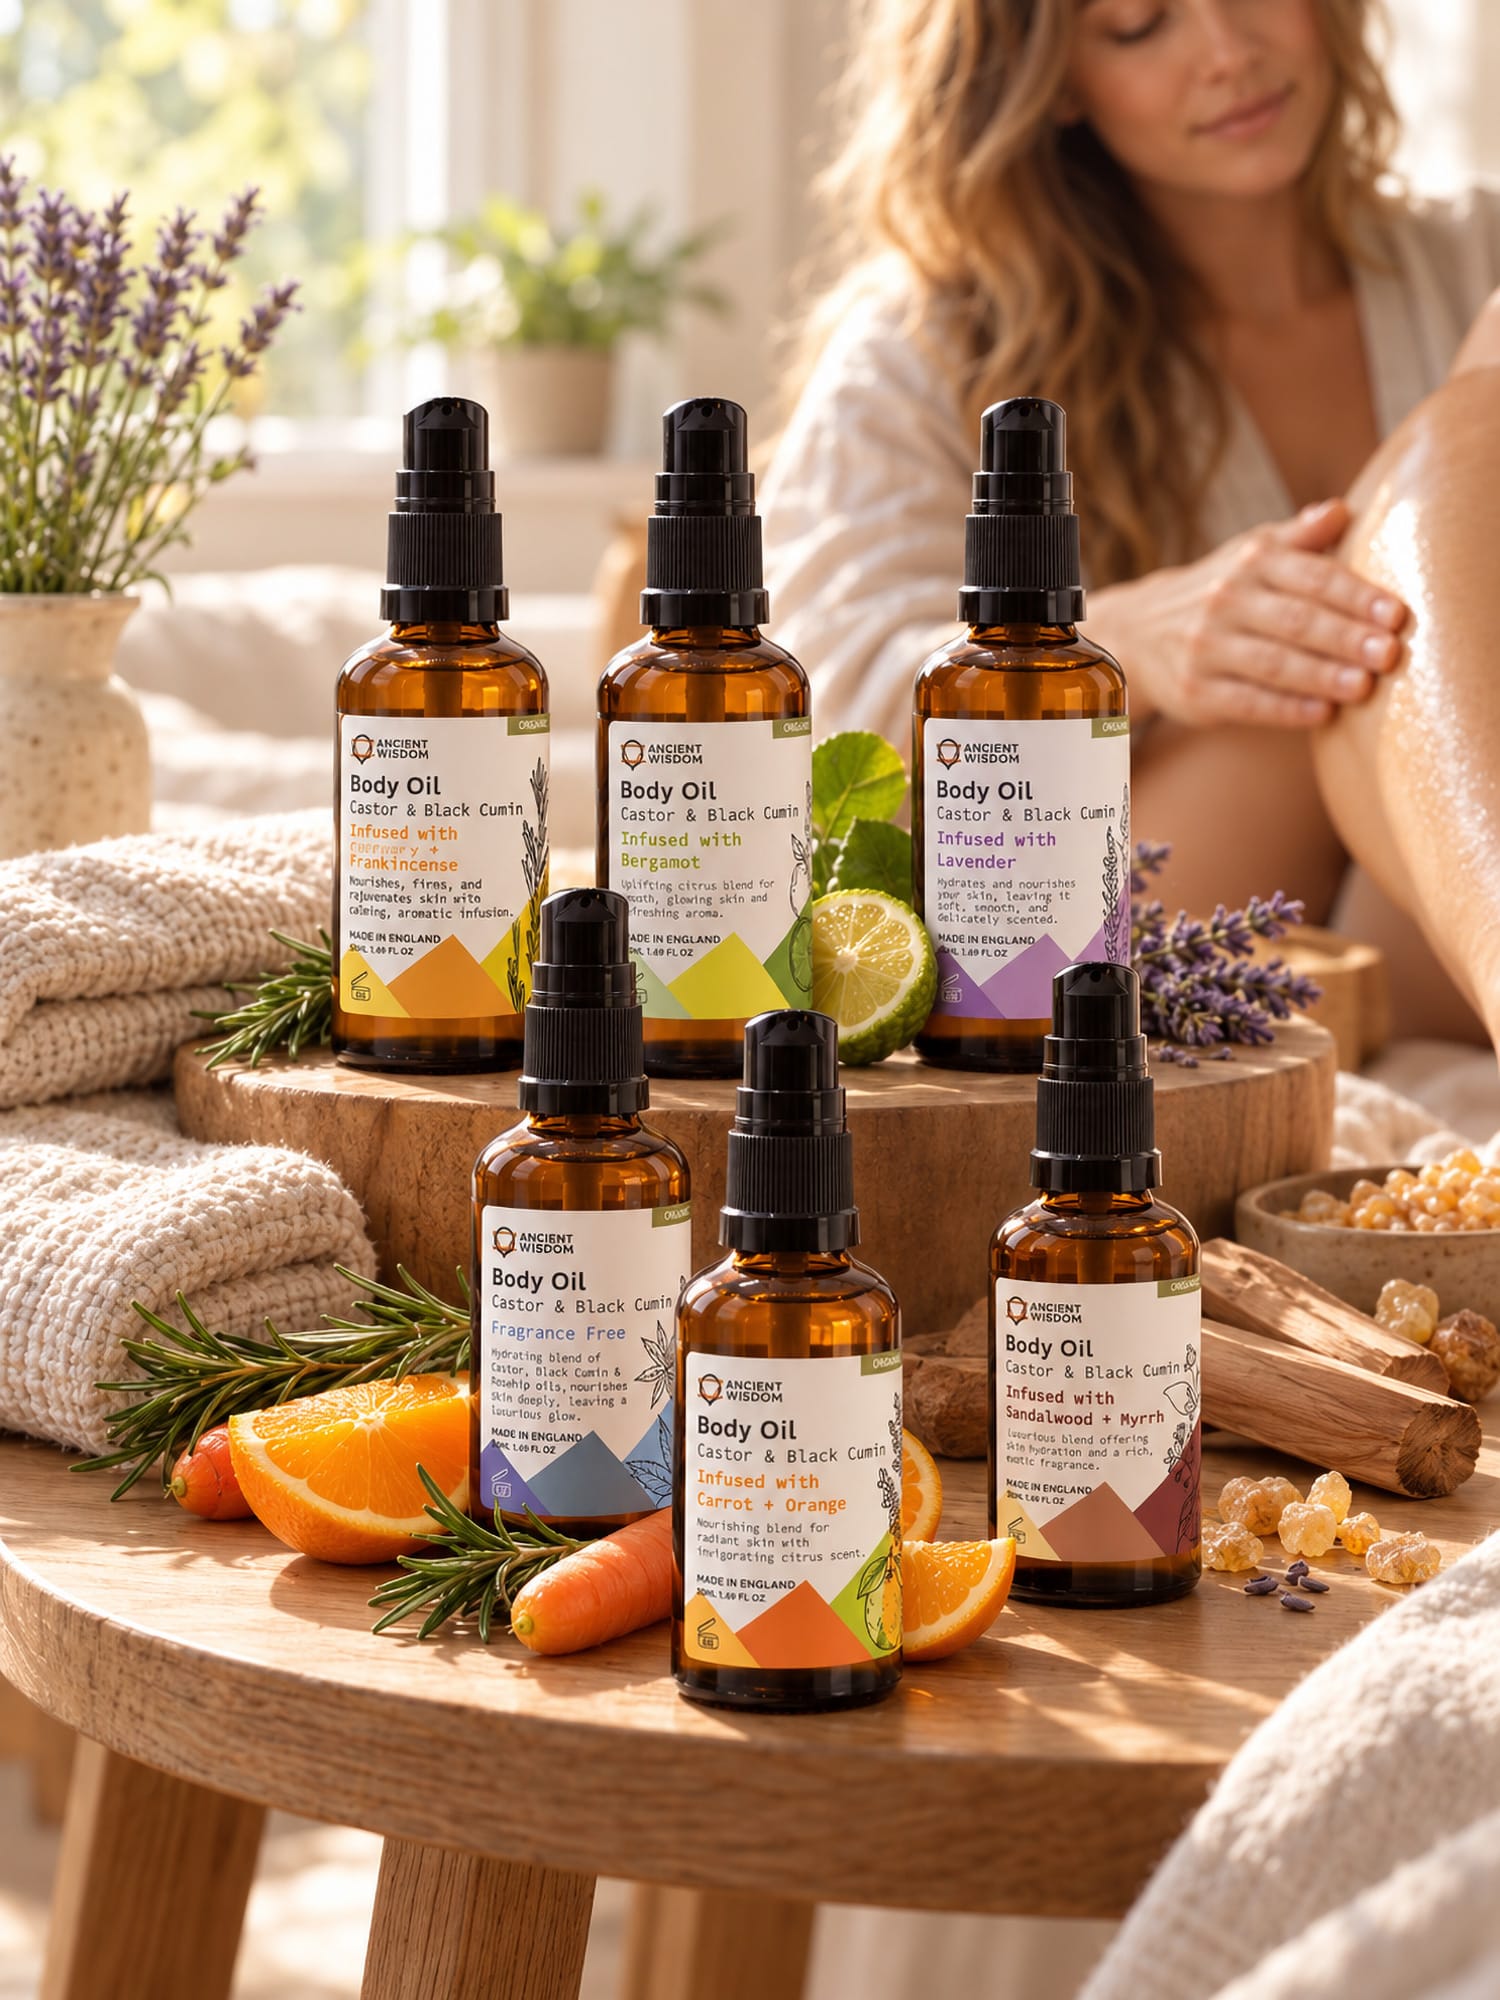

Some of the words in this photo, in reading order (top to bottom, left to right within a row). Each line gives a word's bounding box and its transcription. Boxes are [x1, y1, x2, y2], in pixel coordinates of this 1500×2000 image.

[377, 739, 428, 749] ANCIENT
[648, 744, 702, 754] ANCIENT
[964, 744, 1019, 753] ANCIENT
[377, 748, 428, 759] WISDOM
[648, 754, 702, 764] WISDOM
[965, 754, 1019, 763] WISDOM
[351, 775, 399, 799] Body
[407, 776, 441, 795] Oil
[621, 781, 673, 804] Body
[682, 781, 716, 800] Oil
[937, 780, 989, 804] Body
[998, 781, 1033, 800] Oil
[350, 800, 398, 816] Castor
[407, 804, 416, 816] &
[425, 803, 470, 817] Black
[480, 802, 523, 816] Cumin
[621, 807, 675, 821] Castor
[686, 808, 696, 822] &
[708, 807, 754, 821] Black
[764, 804, 798, 820] Cumin
[937, 806, 991, 821] Castor
[1002, 808, 1012, 821] &
[1024, 807, 1071, 821] Black
[1081, 805, 1115, 820] Cumin
[351, 824, 408, 839] Infused
[417, 825, 458, 841] with
[622, 831, 688, 847] Infused
[700, 832, 741, 847] with
[938, 831, 1003, 846] Infused
[1015, 832, 1055, 847] with
[350, 854, 458, 872] Frankincense
[622, 853, 700, 872] Bergamot
[938, 853, 1016, 869] Lavender
[461, 878, 482, 890] and
[723, 880, 753, 890] blend
[759, 879, 774, 888] for
[993, 880, 1012, 889] and
[1019, 879, 1075, 889] nourishes
[420, 893, 446, 904] skin
[667, 893, 712, 907] glowing
[720, 894, 744, 904] skin
[751, 893, 767, 902] and
[1007, 891, 1052, 904] leaving
[460, 907, 513, 918] infusion.
[1028, 902, 1049, 912] and
[686, 910, 723, 918] aroma.
[1007, 914, 1057, 925] scented.
[376, 933, 386, 941] IN
[389, 934, 441, 943] ENGLAND
[653, 935, 663, 943] IN
[667, 935, 720, 944] ENGLAND
[939, 934, 965, 943] MADE
[982, 936, 1035, 945] ENGLAND
[401, 947, 413, 955] OZ
[667, 948, 678, 957] FL
[994, 949, 1007, 957] OZ
[520, 1233, 573, 1244] ANCIENT
[520, 1242, 573, 1254] WISDOM
[493, 1268, 543, 1295] Body
[552, 1272, 586, 1291] Oil
[492, 1294, 544, 1312] Castor
[555, 1300, 564, 1313] &
[576, 1299, 624, 1313] Black
[635, 1295, 672, 1311] Cumin
[1030, 1303, 1081, 1314] ANCIENT
[1031, 1312, 1082, 1323] WISDOM
[492, 1321, 575, 1341] Fragrance
[587, 1326, 625, 1340] Free
[1006, 1334, 1052, 1360] Body
[1061, 1340, 1093, 1357] Oil
[549, 1352, 582, 1363] blend
[588, 1352, 600, 1363] of
[1006, 1359, 1053, 1377] Castor
[1065, 1366, 1074, 1378] &
[1086, 1365, 1133, 1379] Black
[1143, 1361, 1179, 1377] Cumin
[726, 1380, 782, 1392] ANCIENT
[569, 1395, 614, 1408] leaving
[621, 1397, 627, 1405] a
[726, 1391, 782, 1402] WISDOM
[1007, 1385, 1064, 1403] Infused
[1074, 1391, 1114, 1405] with
[1006, 1404, 1092, 1425] Sandalwood
[1102, 1415, 1111, 1424] +
[1121, 1410, 1164, 1428] Myrrh
[492, 1427, 515, 1439] MADE
[519, 1431, 528, 1440] IN
[531, 1432, 582, 1442] ENGLAND
[698, 1416, 751, 1444] Body
[761, 1420, 796, 1439] Oil
[1062, 1434, 1093, 1445] blend
[543, 1446, 555, 1454] OZ
[698, 1442, 752, 1461] Castor
[765, 1450, 774, 1463] &
[787, 1448, 837, 1463] Black
[848, 1443, 885, 1460] Cumin
[1088, 1448, 1107, 1457] and
[1041, 1457, 1099, 1471] fragrance.
[698, 1469, 765, 1488] Infused
[776, 1474, 819, 1489] with
[1007, 1479, 1029, 1490] MADE
[1031, 1483, 1040, 1491] IN
[1043, 1484, 1092, 1494] ENGLAND
[698, 1491, 753, 1511] Carrot
[764, 1500, 773, 1510] +
[786, 1498, 846, 1515] Orange
[697, 1518, 759, 1536] Nourishing
[767, 1523, 802, 1533] blend
[810, 1523, 829, 1533] for
[698, 1534, 739, 1547] radiant
[747, 1537, 774, 1547] skin
[782, 1537, 809, 1547] with
[782, 1552, 823, 1562] citrus
[830, 1549, 865, 1560] scent.
[697, 1574, 724, 1586] MADE
[727, 1578, 737, 1587] IN
[740, 1579, 796, 1590] ENGLAND
[738, 1593, 749, 1601] FL
[752, 1594, 765, 1602] OZ
